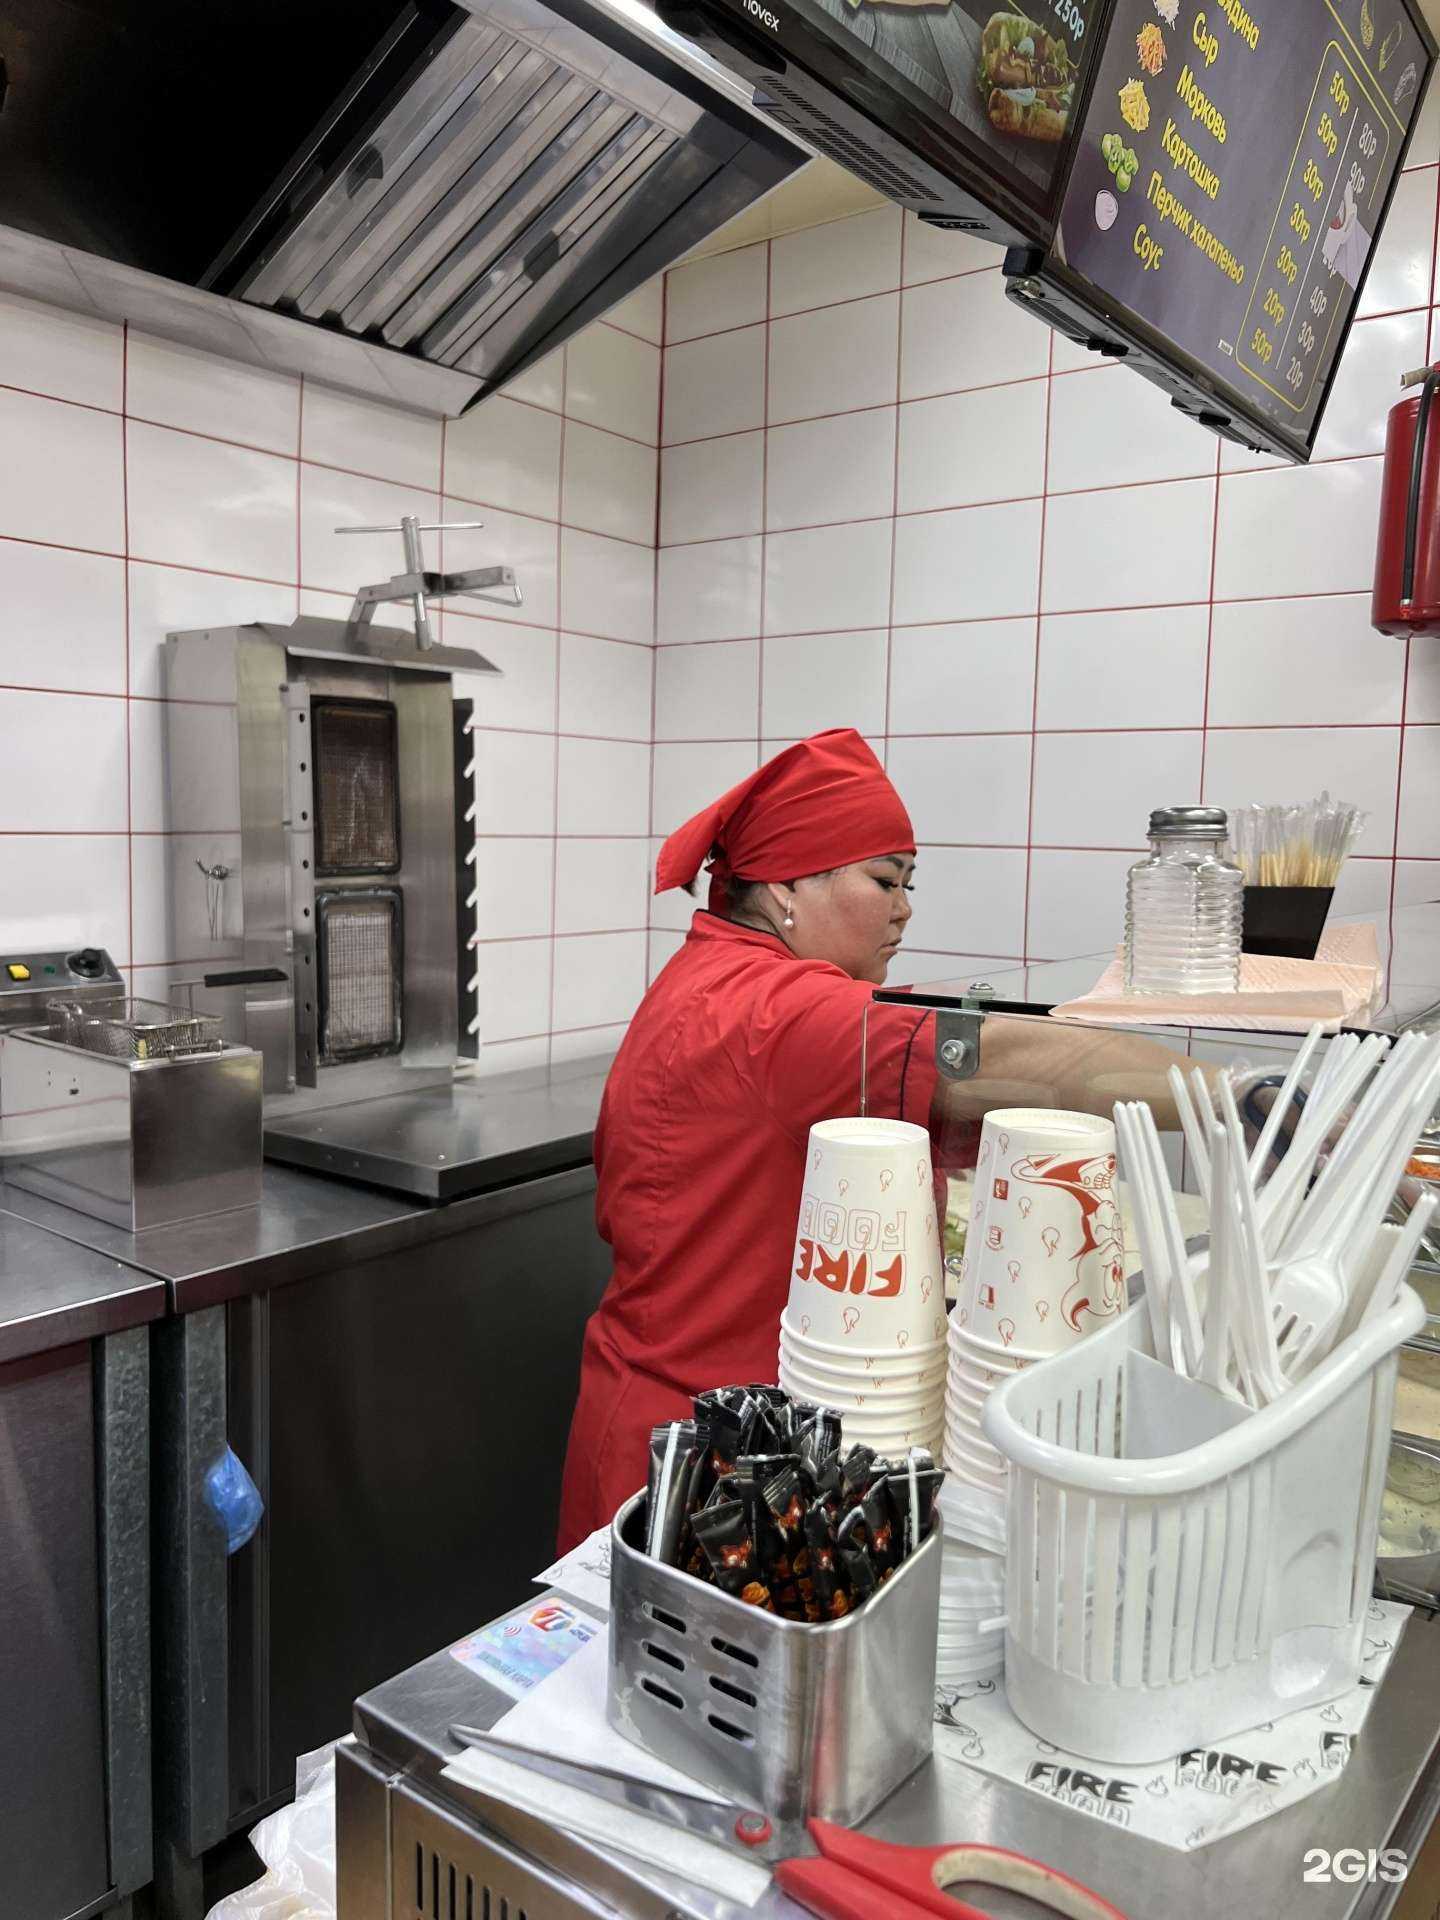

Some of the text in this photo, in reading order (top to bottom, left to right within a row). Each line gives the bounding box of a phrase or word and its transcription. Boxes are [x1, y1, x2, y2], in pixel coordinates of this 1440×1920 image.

[1193, 11, 1220, 69] Сыр
[1176, 64, 1227, 144] Морковь
[1329, 69, 1350, 118] 50гр
[1317, 111, 1338, 158] 50гр
[1359, 122, 1378, 160] 80р
[1161, 117, 1221, 200] Картошка
[1303, 158, 1324, 203] 30гр
[1348, 160, 1366, 195] 90р
[1133, 223, 1164, 271] Соус
[1146, 170, 1245, 285] Перчик халапеньо
[1290, 202, 1312, 248] 30гр
[1276, 244, 1299, 287] 30гр
[1263, 287, 1287, 328] 20гр
[1309, 285, 1328, 318] 40р
[1251, 327, 1274, 366] 50гр
[1298, 320, 1316, 357] 30р
[1286, 356, 1304, 392] 20р
[795, 1238, 907, 1298] FIRE
[1025, 1760, 1139, 1804] FIRE
[1176, 1748, 1288, 1787] FIRE
